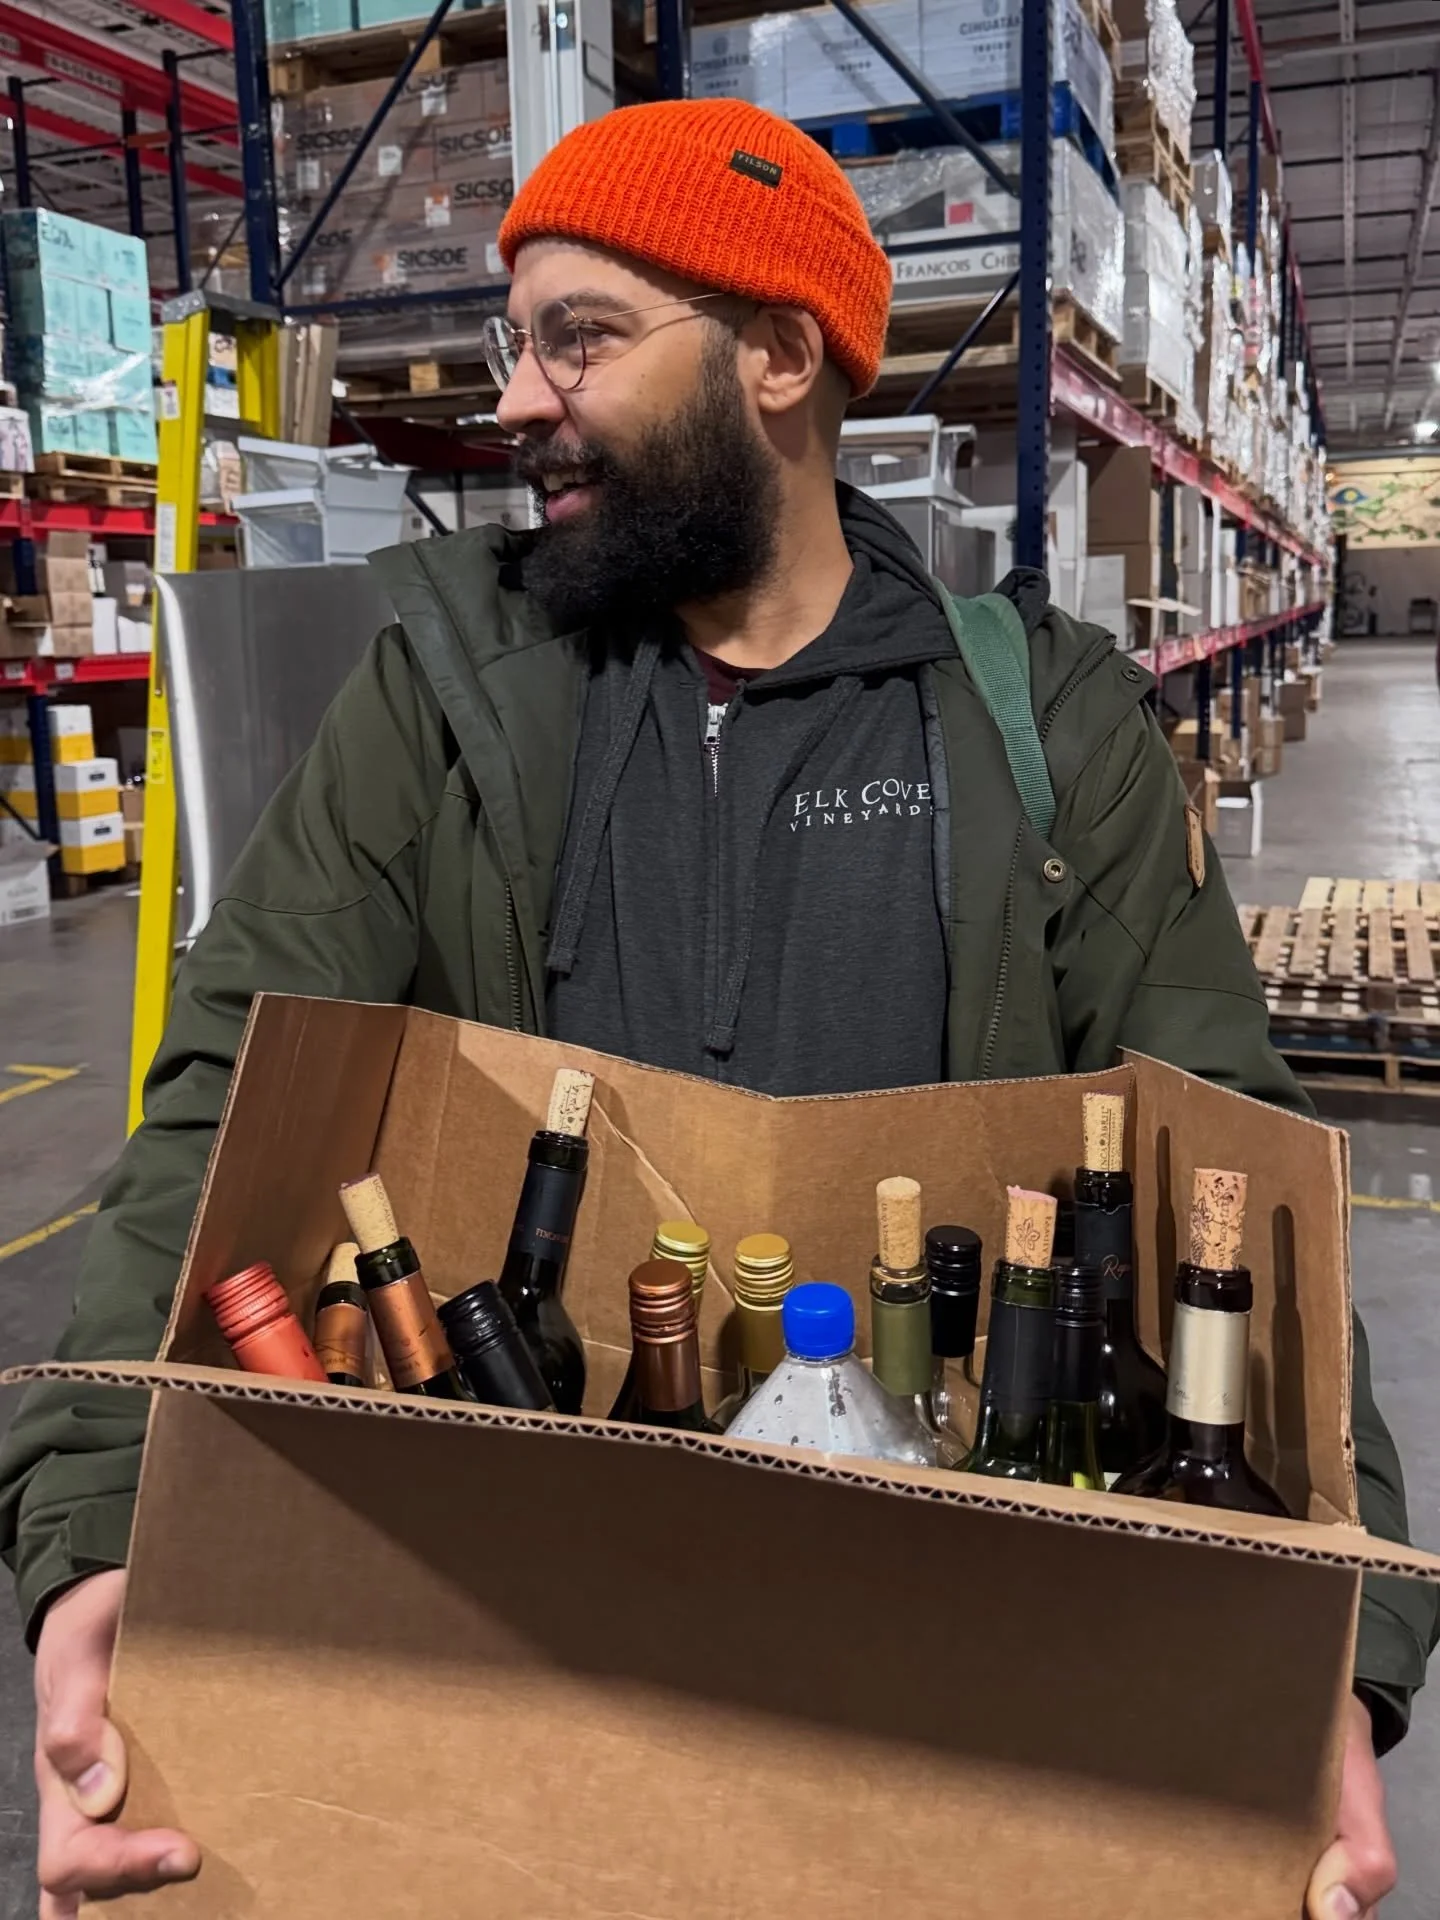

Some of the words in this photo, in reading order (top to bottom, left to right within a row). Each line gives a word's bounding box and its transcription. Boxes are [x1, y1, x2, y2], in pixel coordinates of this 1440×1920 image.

[737, 153, 778, 176] FILSON
[397, 246, 469, 268] SICSOE
[794, 787, 849, 818] ELK
[860, 778, 931, 805] COVE
